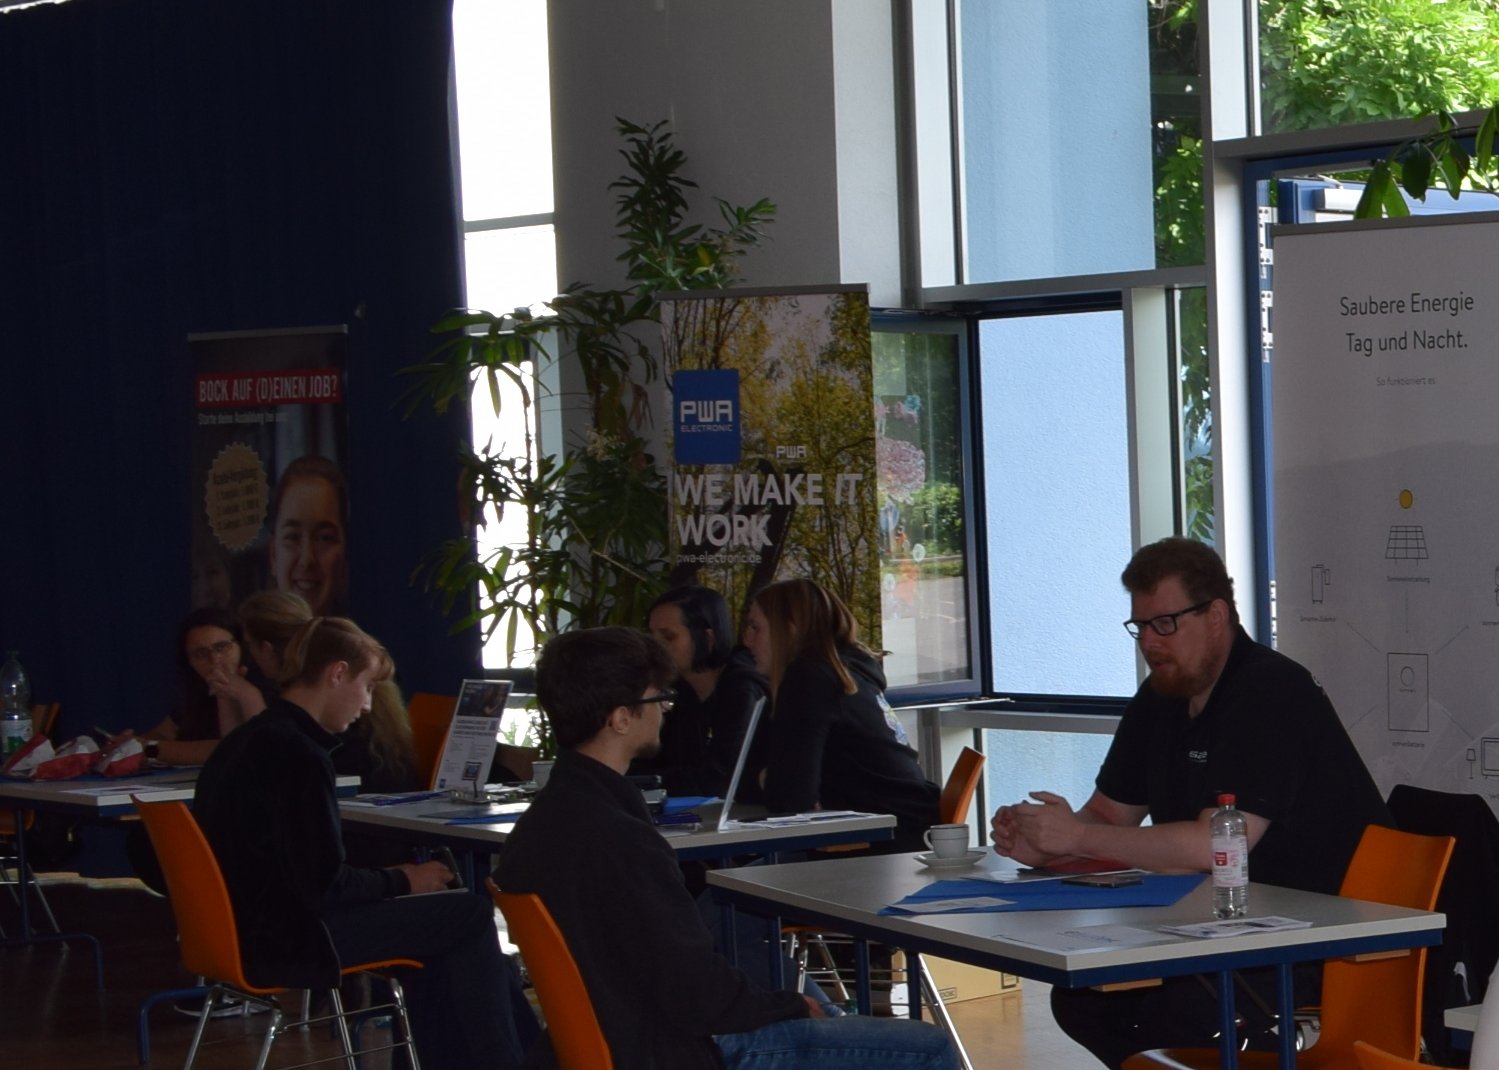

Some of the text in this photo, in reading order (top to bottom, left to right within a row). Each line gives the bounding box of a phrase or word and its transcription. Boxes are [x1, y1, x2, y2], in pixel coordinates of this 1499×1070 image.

[1340, 292, 1475, 317] Saubere Energie
[1346, 329, 1468, 357] Tag und Nacht.
[200, 375, 337, 403] BOCK AUF (D)EINEN JOB?
[680, 400, 733, 423] PWA
[681, 424, 733, 433] ELECTRONIC
[776, 445, 807, 459] PWA
[675, 474, 863, 506] WE MAKE IT
[676, 516, 773, 546] WORK
[677, 552, 762, 564] pwa-electronic.de
